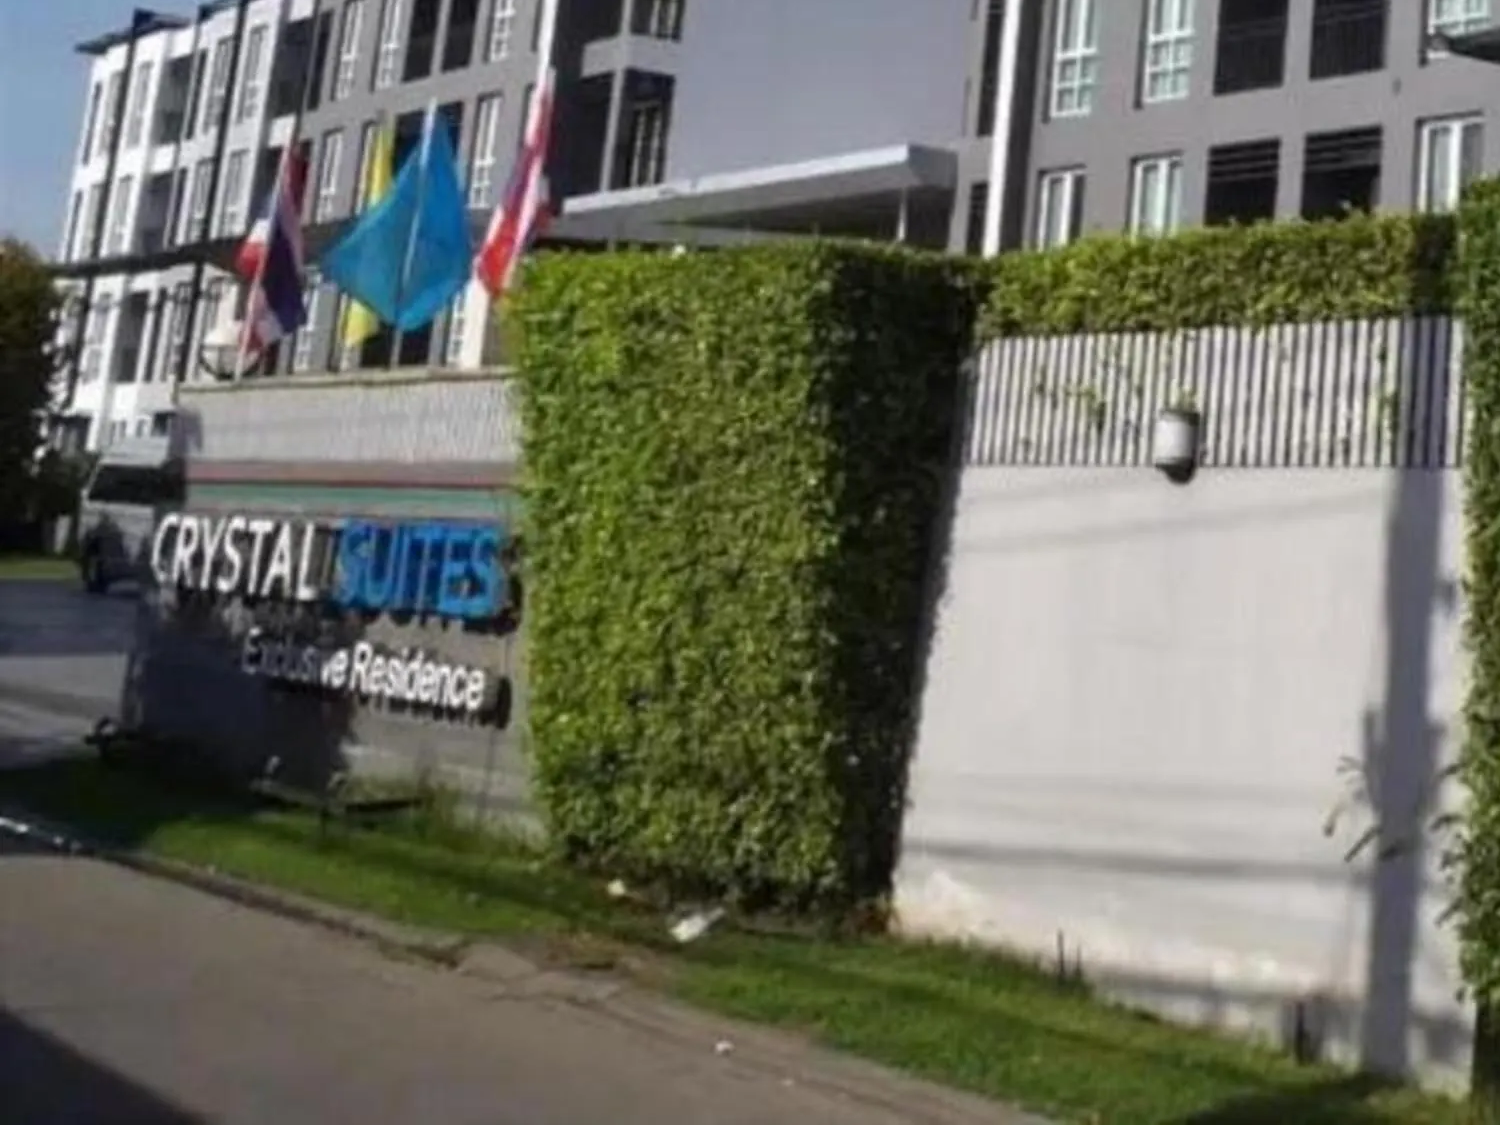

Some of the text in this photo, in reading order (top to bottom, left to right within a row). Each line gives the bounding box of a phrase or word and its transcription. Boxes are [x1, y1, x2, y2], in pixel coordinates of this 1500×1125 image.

[151, 511, 506, 618] CRYSTAL SUITES
[351, 641, 485, 711] Residence
